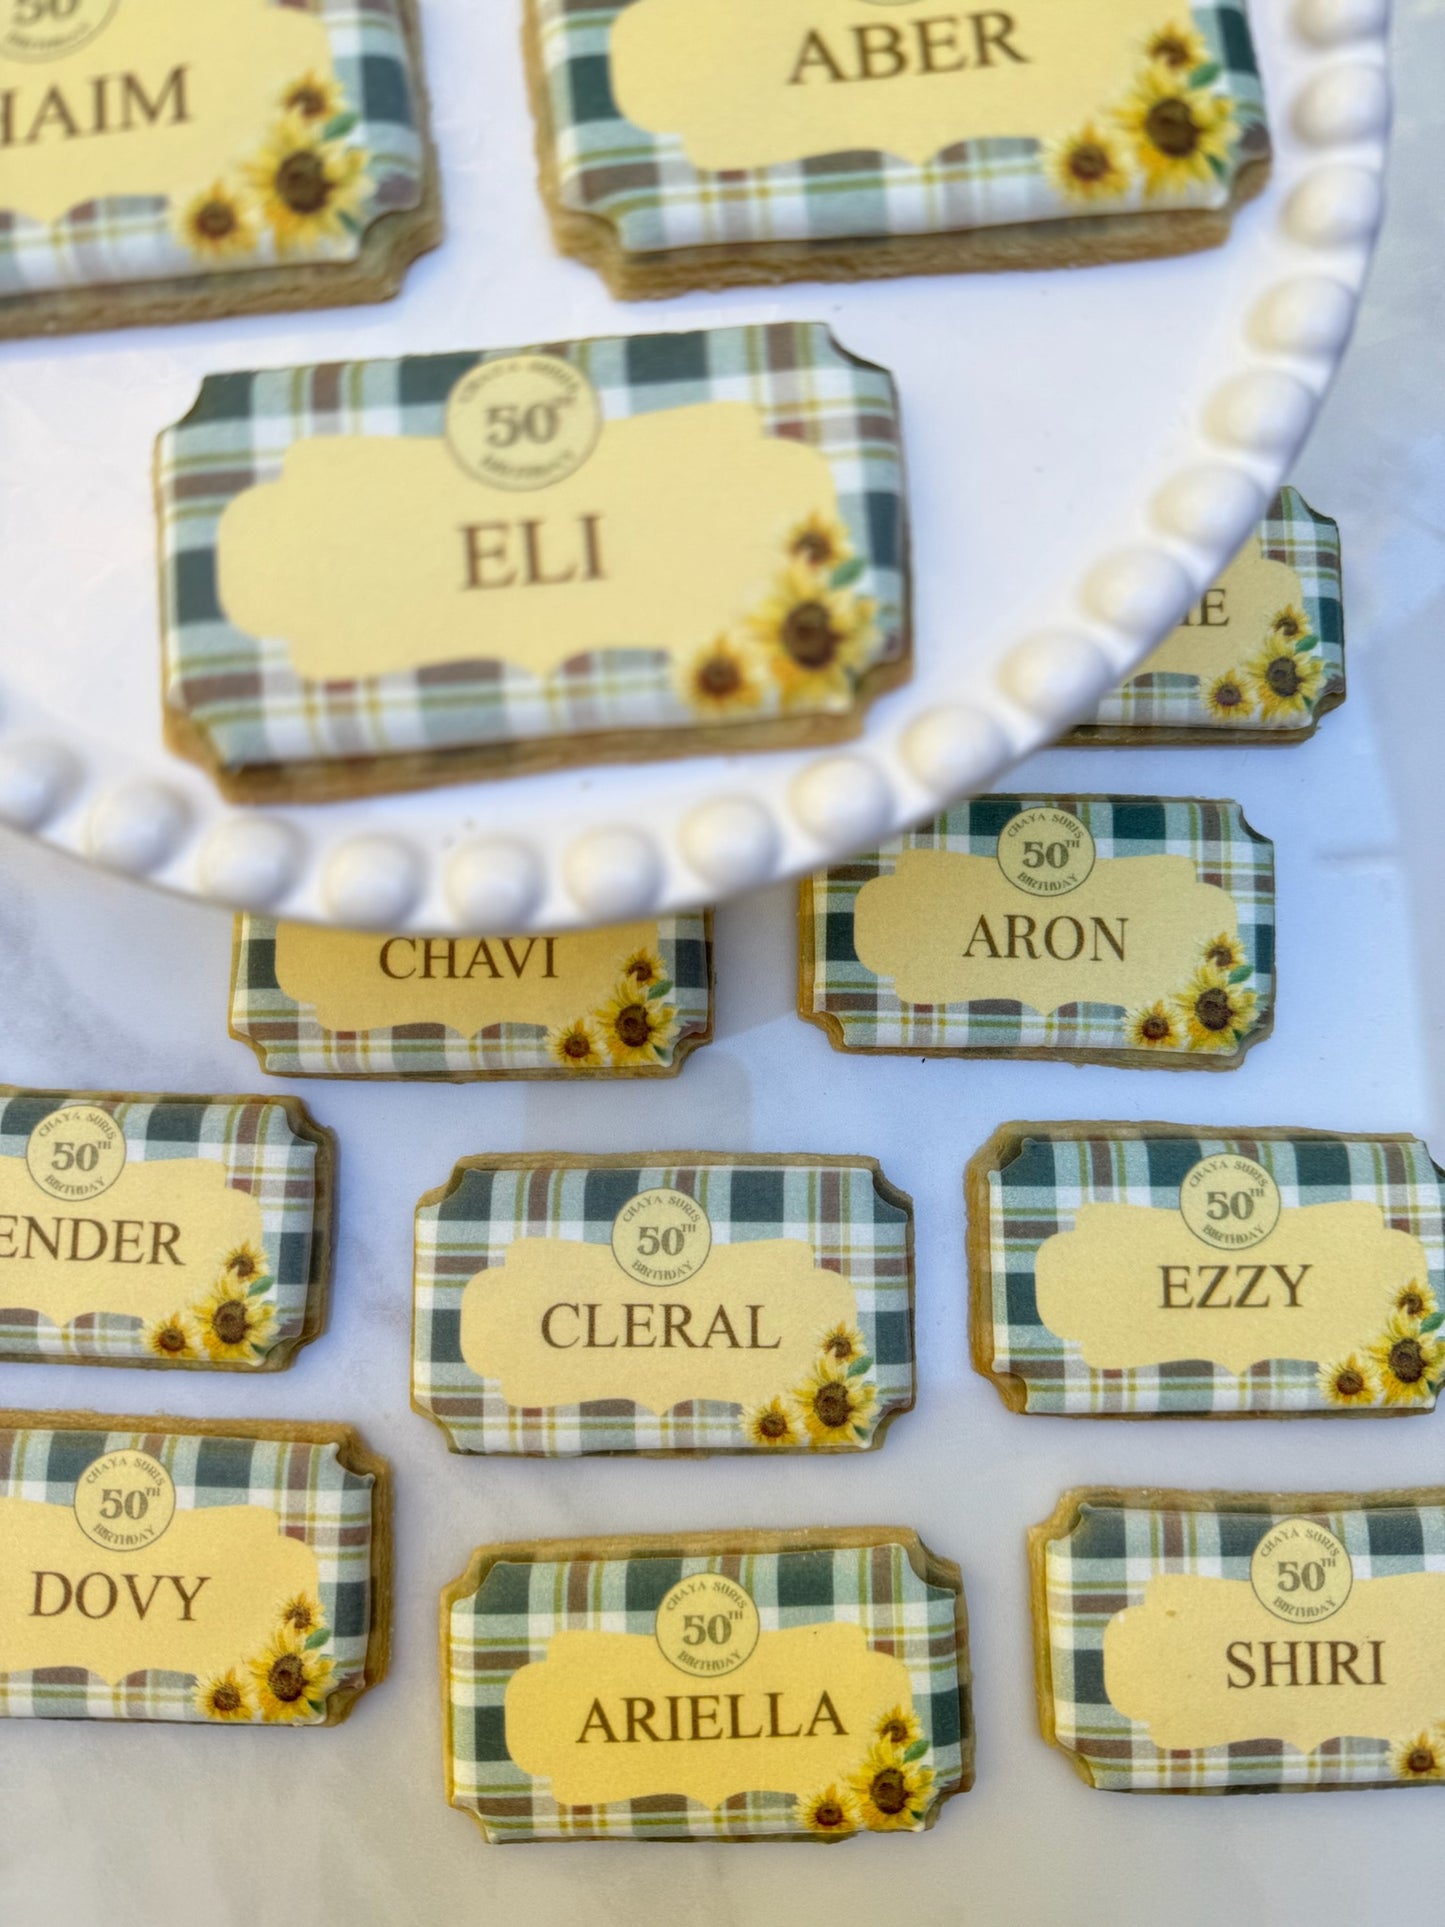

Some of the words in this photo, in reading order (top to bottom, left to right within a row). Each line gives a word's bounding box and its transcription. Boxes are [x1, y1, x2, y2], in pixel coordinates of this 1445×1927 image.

[785, 10, 1033, 86] ABER
[456, 511, 609, 591] ELI
[1007, 813, 1047, 838] CHAYA
[1016, 871, 1078, 891] BIRTHDAY
[962, 914, 1129, 962] ARON
[379, 936, 559, 979] CHAVI
[38, 1112, 81, 1137] CHAYA
[44, 1174, 105, 1195] BIRTHDAY
[1189, 1160, 1229, 1188] CHAYA
[623, 1195, 664, 1223] CHAYA
[1202, 1224, 1265, 1244] BIRTHDAY
[631, 1259, 694, 1281] BIRTHDAY
[1157, 1264, 1313, 1309] EZZY
[541, 1302, 782, 1349] CLERAL
[86, 1457, 128, 1484] CHAYA
[93, 1523, 156, 1545] BIRTHDAY
[1260, 1527, 1300, 1558] CHAYA
[28, 1571, 211, 1621] DOVY
[666, 1581, 707, 1612] CHAYA
[1272, 1595, 1337, 1617] BIRTHDAY
[677, 1649, 742, 1671] BIRTHDAY
[1226, 1641, 1387, 1689] SHIRI
[575, 1690, 849, 1743] ARIELLA
